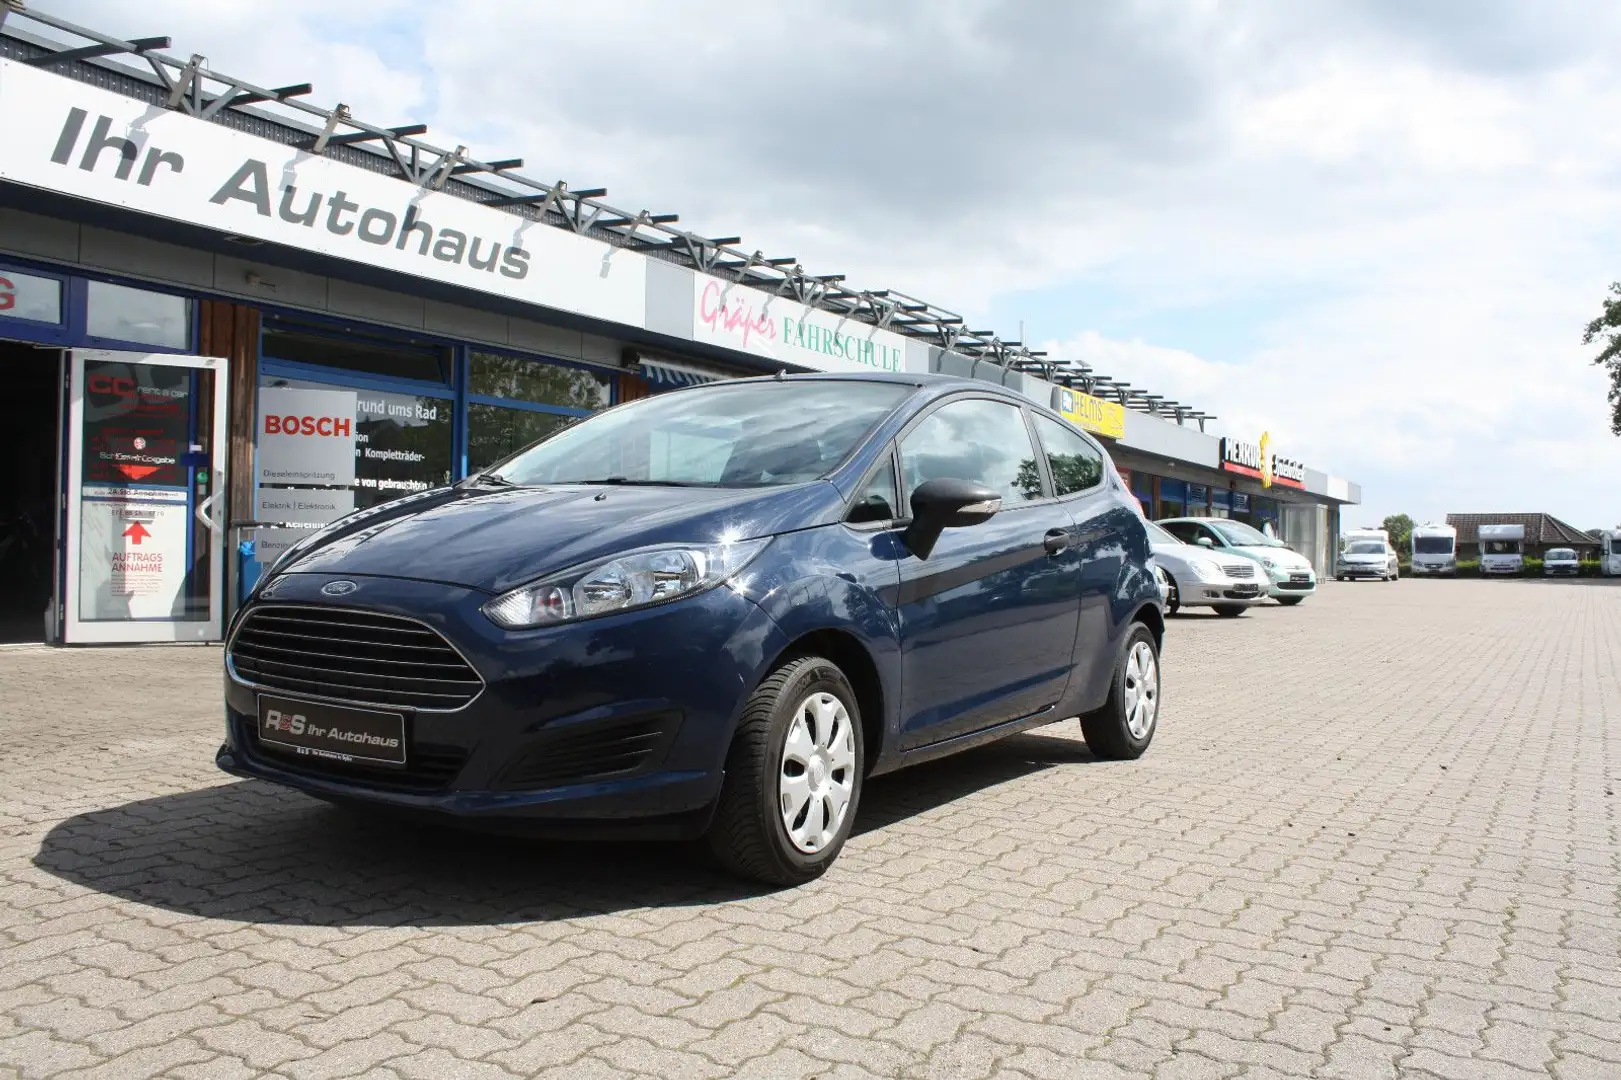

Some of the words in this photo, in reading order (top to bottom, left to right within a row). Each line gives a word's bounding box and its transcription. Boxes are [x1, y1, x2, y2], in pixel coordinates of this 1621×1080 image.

[50, 106, 184, 187] Ihr
[210, 157, 531, 281] Autohaus
[700, 280, 777, 348] Gräper
[783, 316, 901, 372] FAHRSCHULE
[357, 400, 385, 414] rund
[388, 404, 412, 417] ums
[415, 405, 437, 420] Rad
[264, 414, 350, 437] BOSCH
[365, 447, 425, 462] Kompletträder-
[263, 469, 335, 481] Dieseleinspritzung
[362, 479, 377, 488] von
[262, 501, 291, 511] Elektrik
[111, 552, 164, 562] AUFTRAGS
[111, 563, 164, 573] ANNAHME
[327, 727, 400, 749] Autohaus
